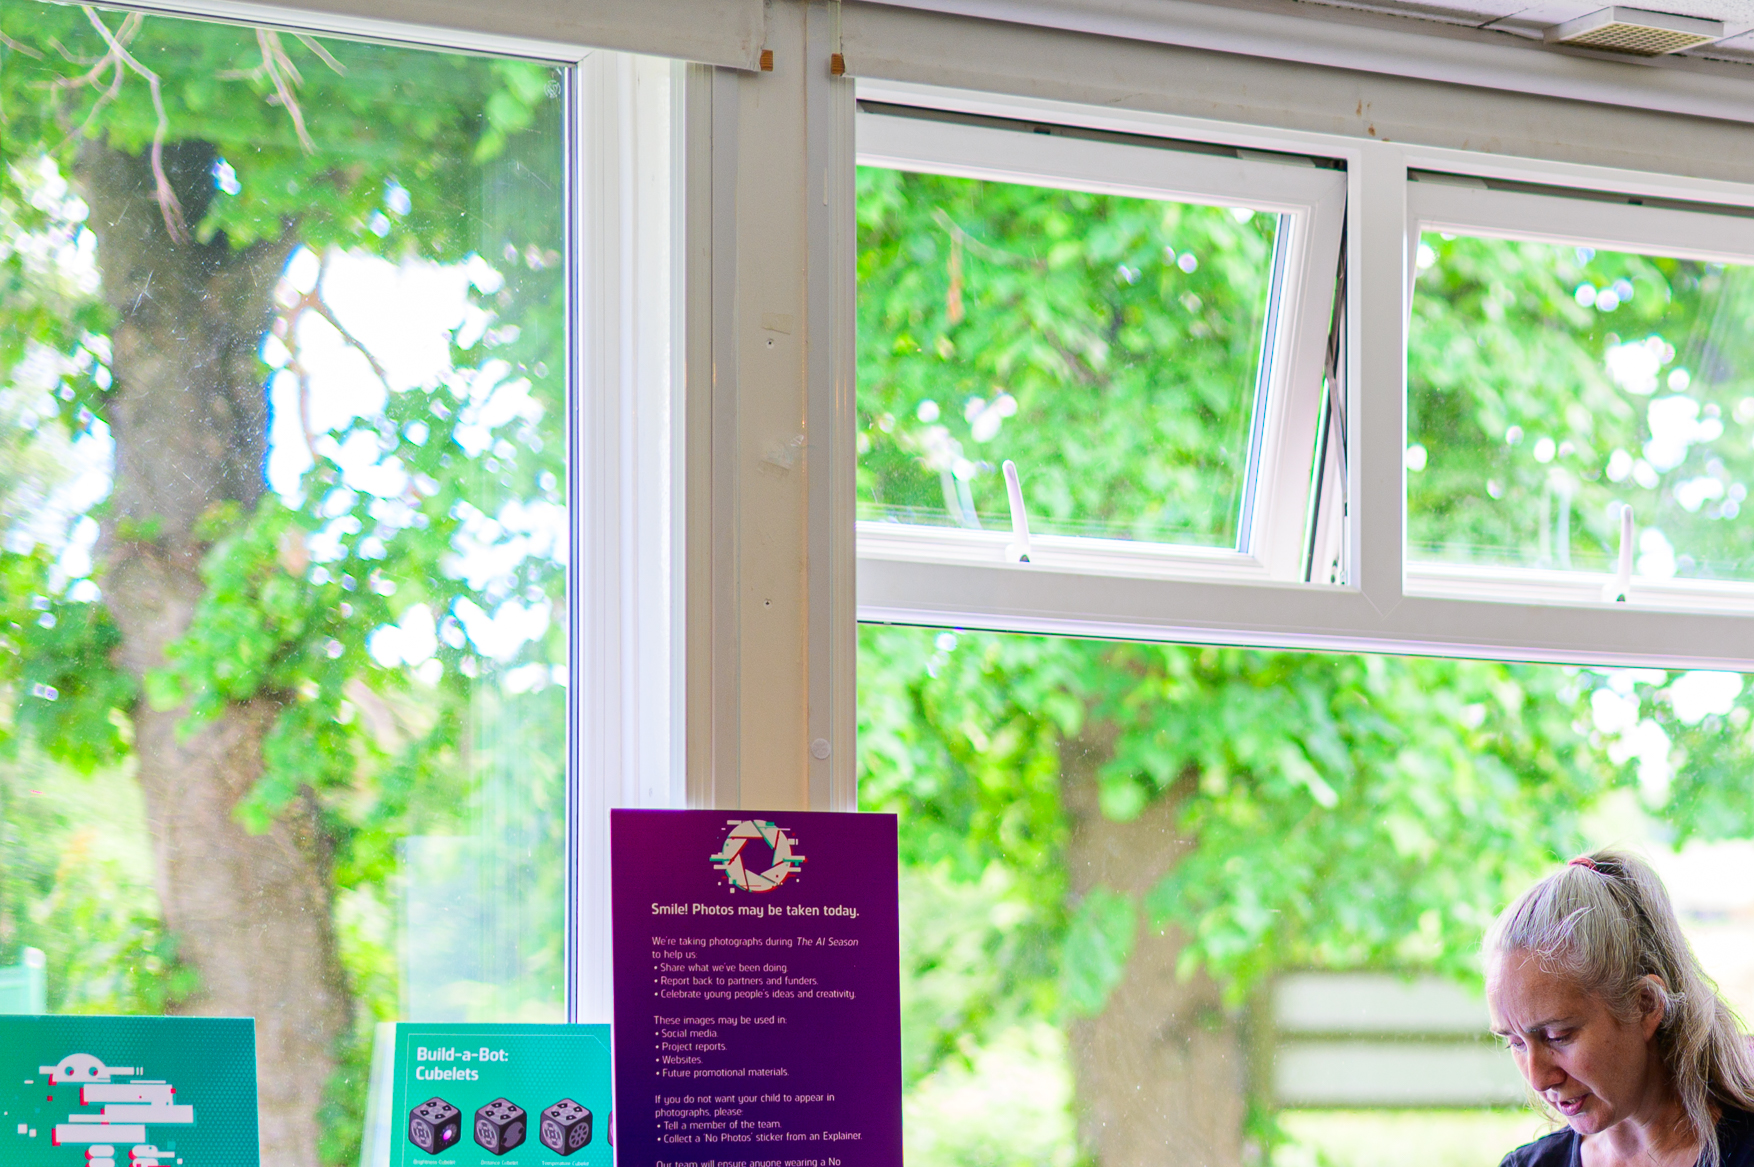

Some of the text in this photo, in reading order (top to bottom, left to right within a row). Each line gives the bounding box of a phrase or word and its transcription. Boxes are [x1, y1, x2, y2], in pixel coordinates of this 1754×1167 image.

[652, 903, 859, 918] Smile! Photos may be taken today.
[679, 936, 706, 947] taking
[709, 936, 762, 947] photographs
[766, 937, 792, 947] during
[797, 936, 813, 946] The
[816, 937, 825, 945] AI
[829, 936, 858, 946] Season
[652, 950, 661, 958] to
[664, 949, 682, 959] help
[660, 962, 685, 972] Share
[688, 963, 709, 971] what
[739, 963, 760, 971] been
[661, 975, 818, 986] Report back to partners and funders.
[661, 988, 701, 998] Celebrate
[704, 990, 731, 1000] young
[773, 989, 794, 998] ideas
[798, 989, 813, 998] and
[816, 990, 856, 999] creativity.
[654, 1015, 680, 1024] These
[684, 1017, 715, 1026] images
[718, 1017, 737, 1026] may
[741, 1015, 751, 1024] be
[754, 1015, 774, 1024] used
[662, 1028, 687, 1037] Social
[662, 1041, 727, 1052] Project reports.
[416, 1046, 509, 1062] Build-a-Bot:
[662, 1055, 702, 1064] Websites.
[415, 1066, 479, 1081] Cubelets
[663, 1067, 789, 1078] Future promotional materials.
[655, 1094, 660, 1103] If
[664, 1096, 680, 1105] you
[684, 1094, 694, 1103] do
[698, 1095, 711, 1103] not
[715, 1094, 735, 1102] want
[738, 1095, 757, 1104] your
[761, 1093, 780, 1102] child
[784, 1094, 792, 1102] to
[795, 1094, 823, 1103] appear
[664, 1120, 678, 1129] Tell
[690, 1120, 725, 1129] member
[730, 1119, 737, 1128] of
[741, 1120, 755, 1128] the
[758, 1120, 781, 1128] team.
[664, 1133, 691, 1143] Collect
[756, 1132, 783, 1141] sticker
[787, 1131, 806, 1140] from
[823, 1130, 862, 1141] Explainer.
[701, 1159, 714, 1167] will
[718, 1160, 746, 1167] ensure
[785, 1159, 817, 1167] wearing
[829, 1157, 841, 1165] No
